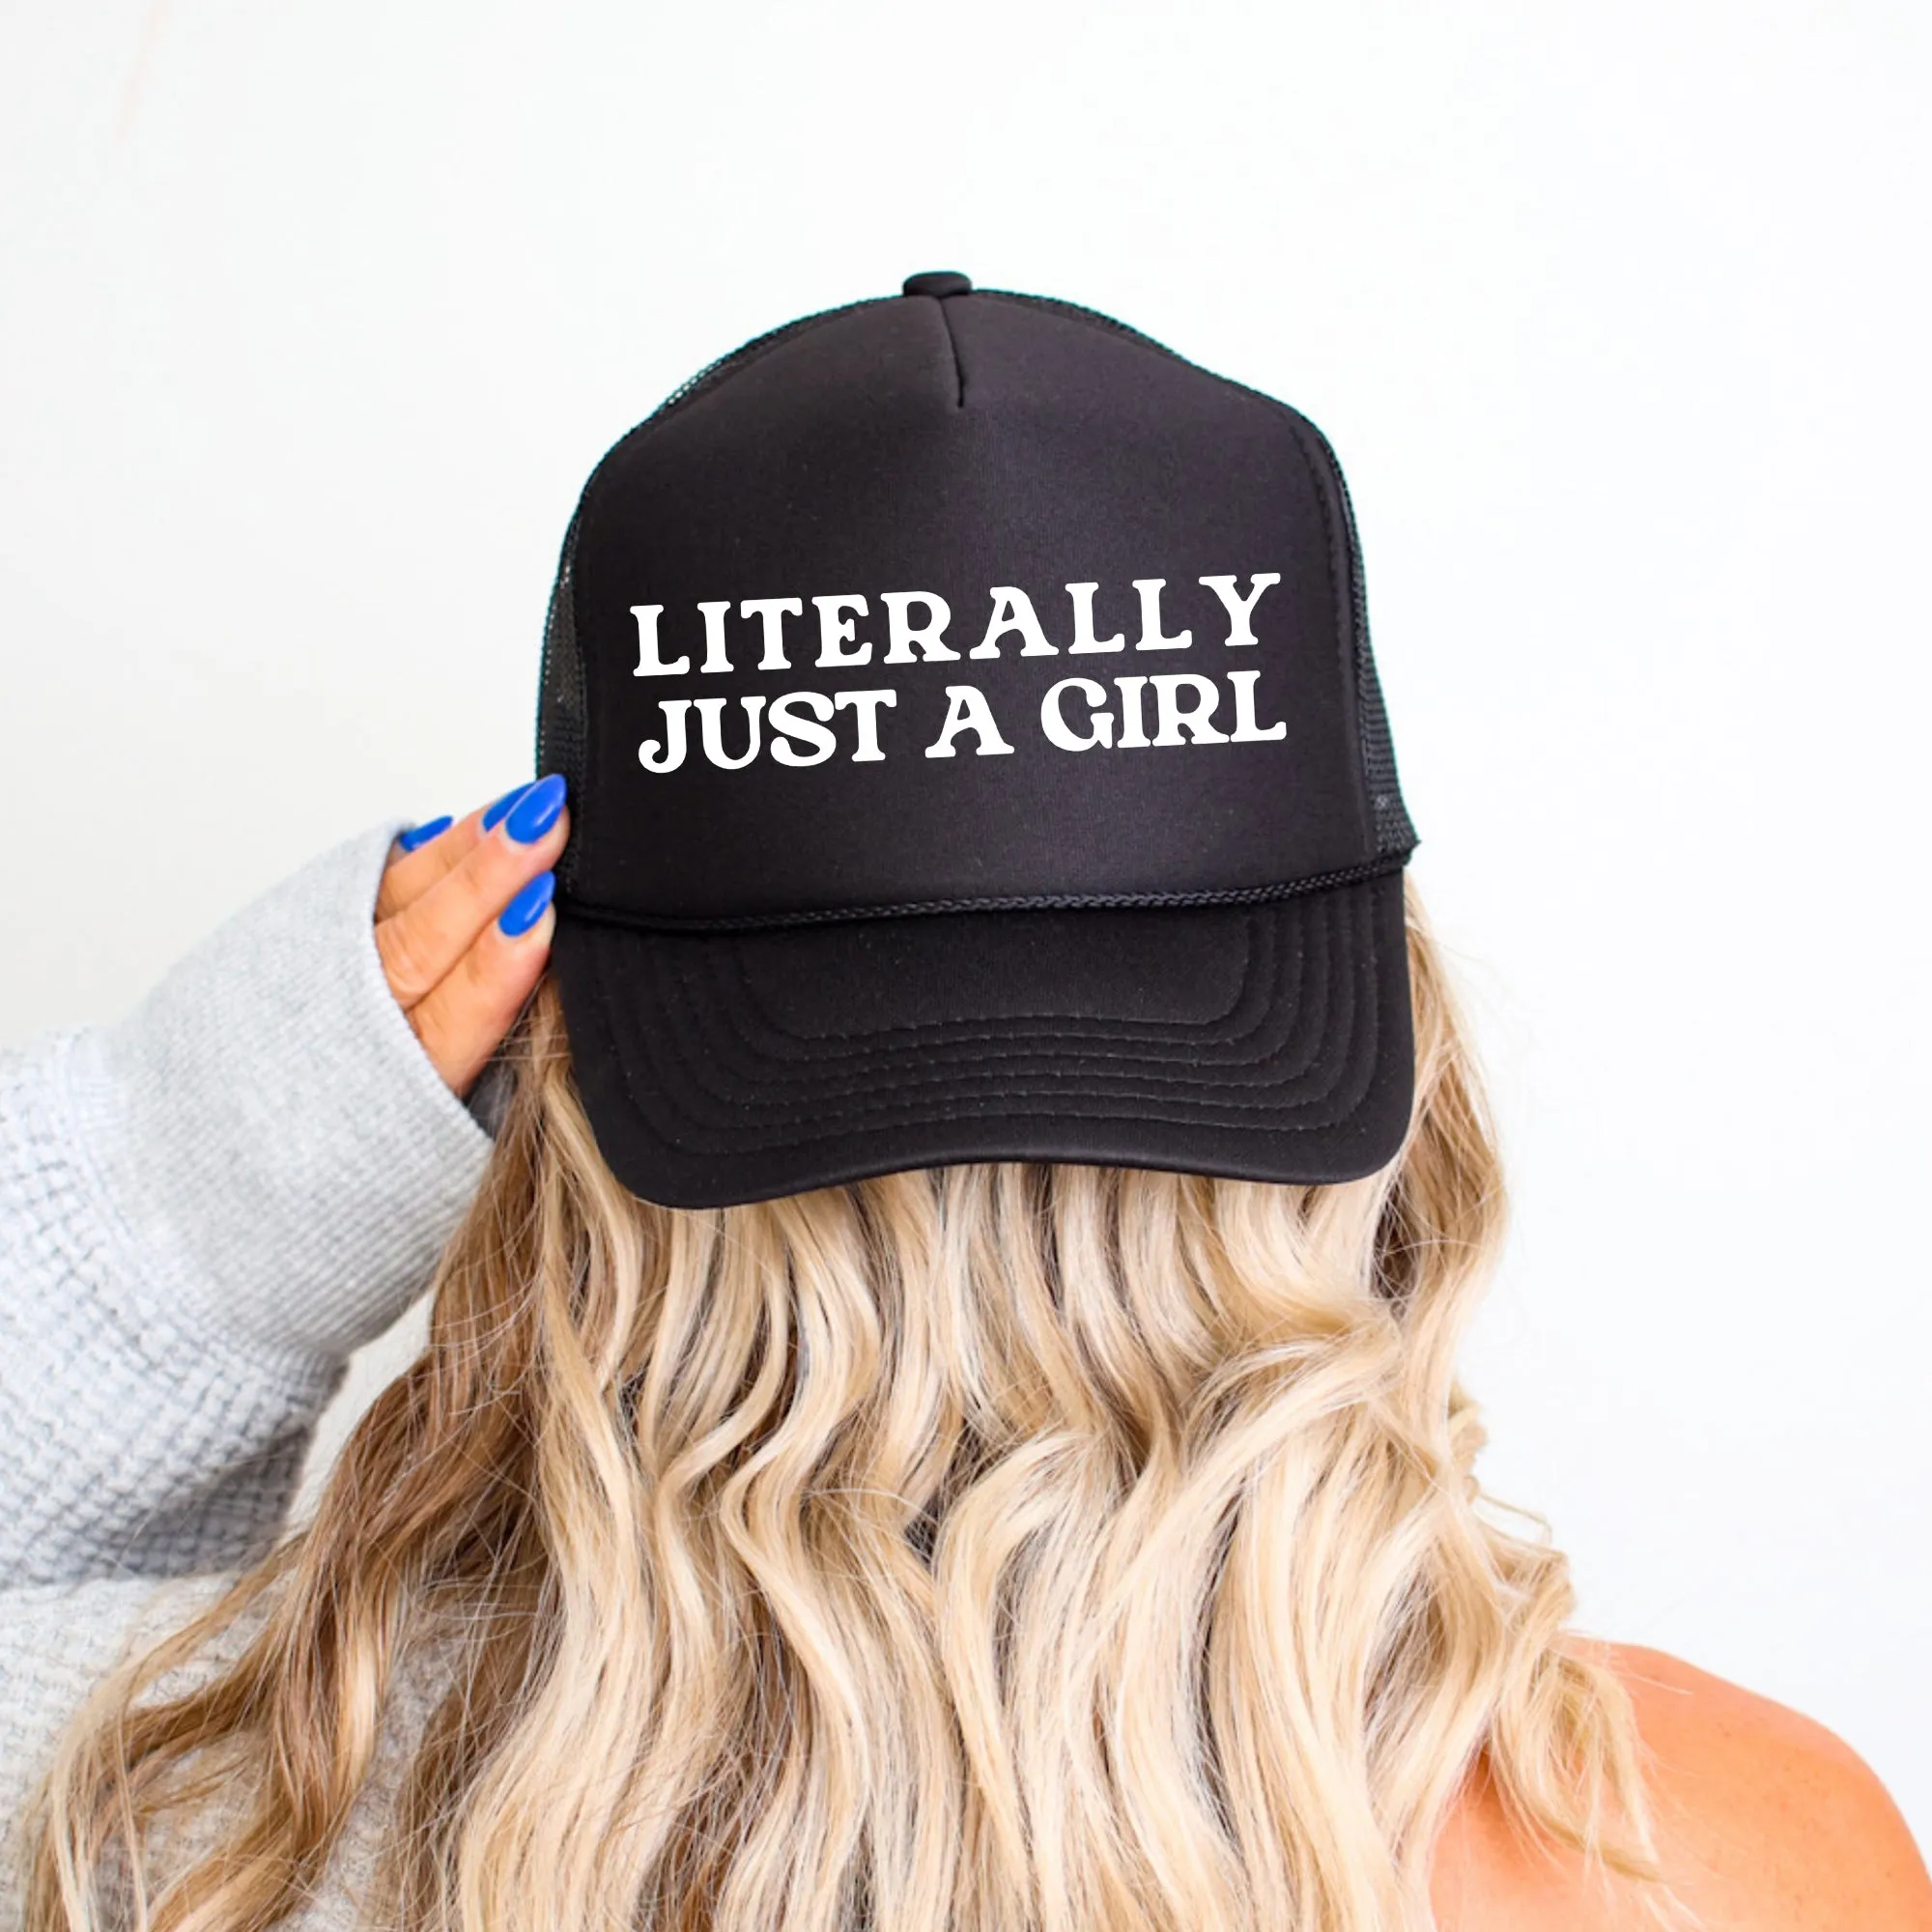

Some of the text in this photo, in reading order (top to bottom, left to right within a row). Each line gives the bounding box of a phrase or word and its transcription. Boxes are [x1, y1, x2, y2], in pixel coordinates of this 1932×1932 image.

[629, 572, 1281, 677] LITERALLY
[638, 669, 1288, 774] JUST A GIRL
